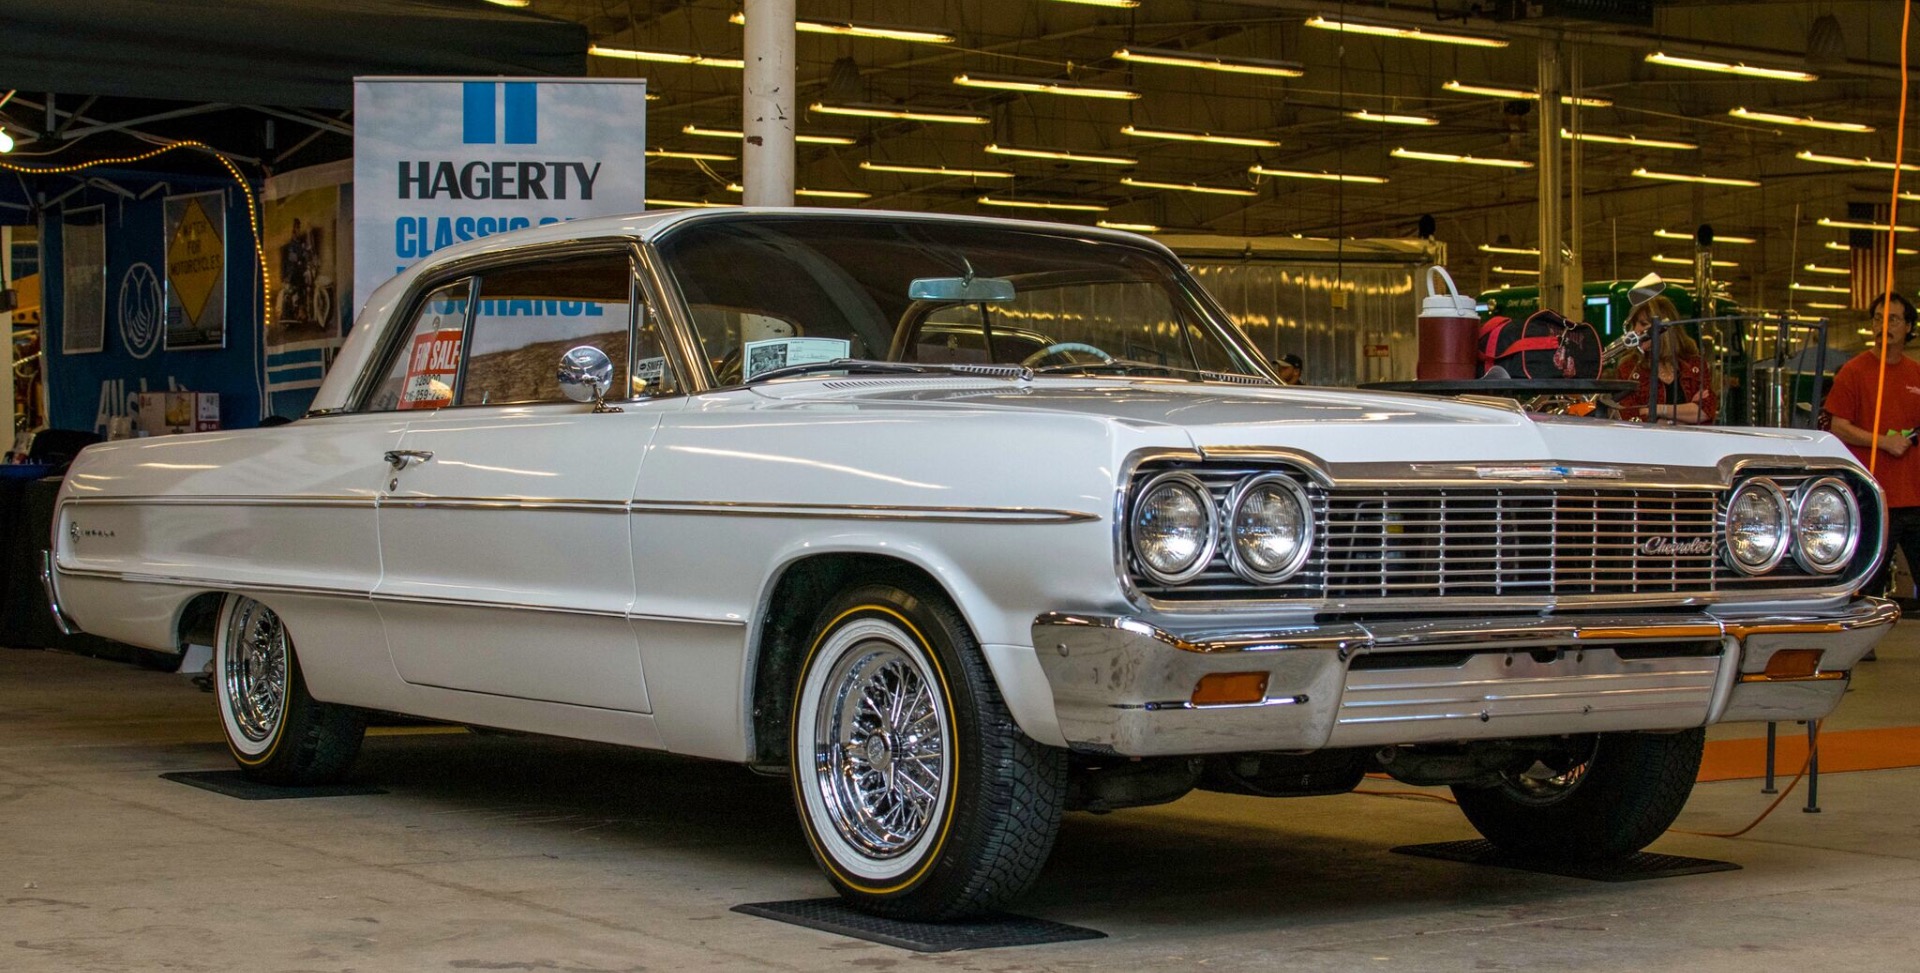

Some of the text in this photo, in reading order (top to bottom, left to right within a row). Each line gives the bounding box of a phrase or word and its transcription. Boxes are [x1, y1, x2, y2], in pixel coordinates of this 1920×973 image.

[398, 161, 601, 200] HAGERTY
[187, 240, 201, 255] FOR
[395, 216, 530, 259] CLAS
[170, 254, 221, 276] MOTORCYCLES
[413, 339, 462, 373] FOR SALE
[1640, 536, 1712, 555] Chevrolet
